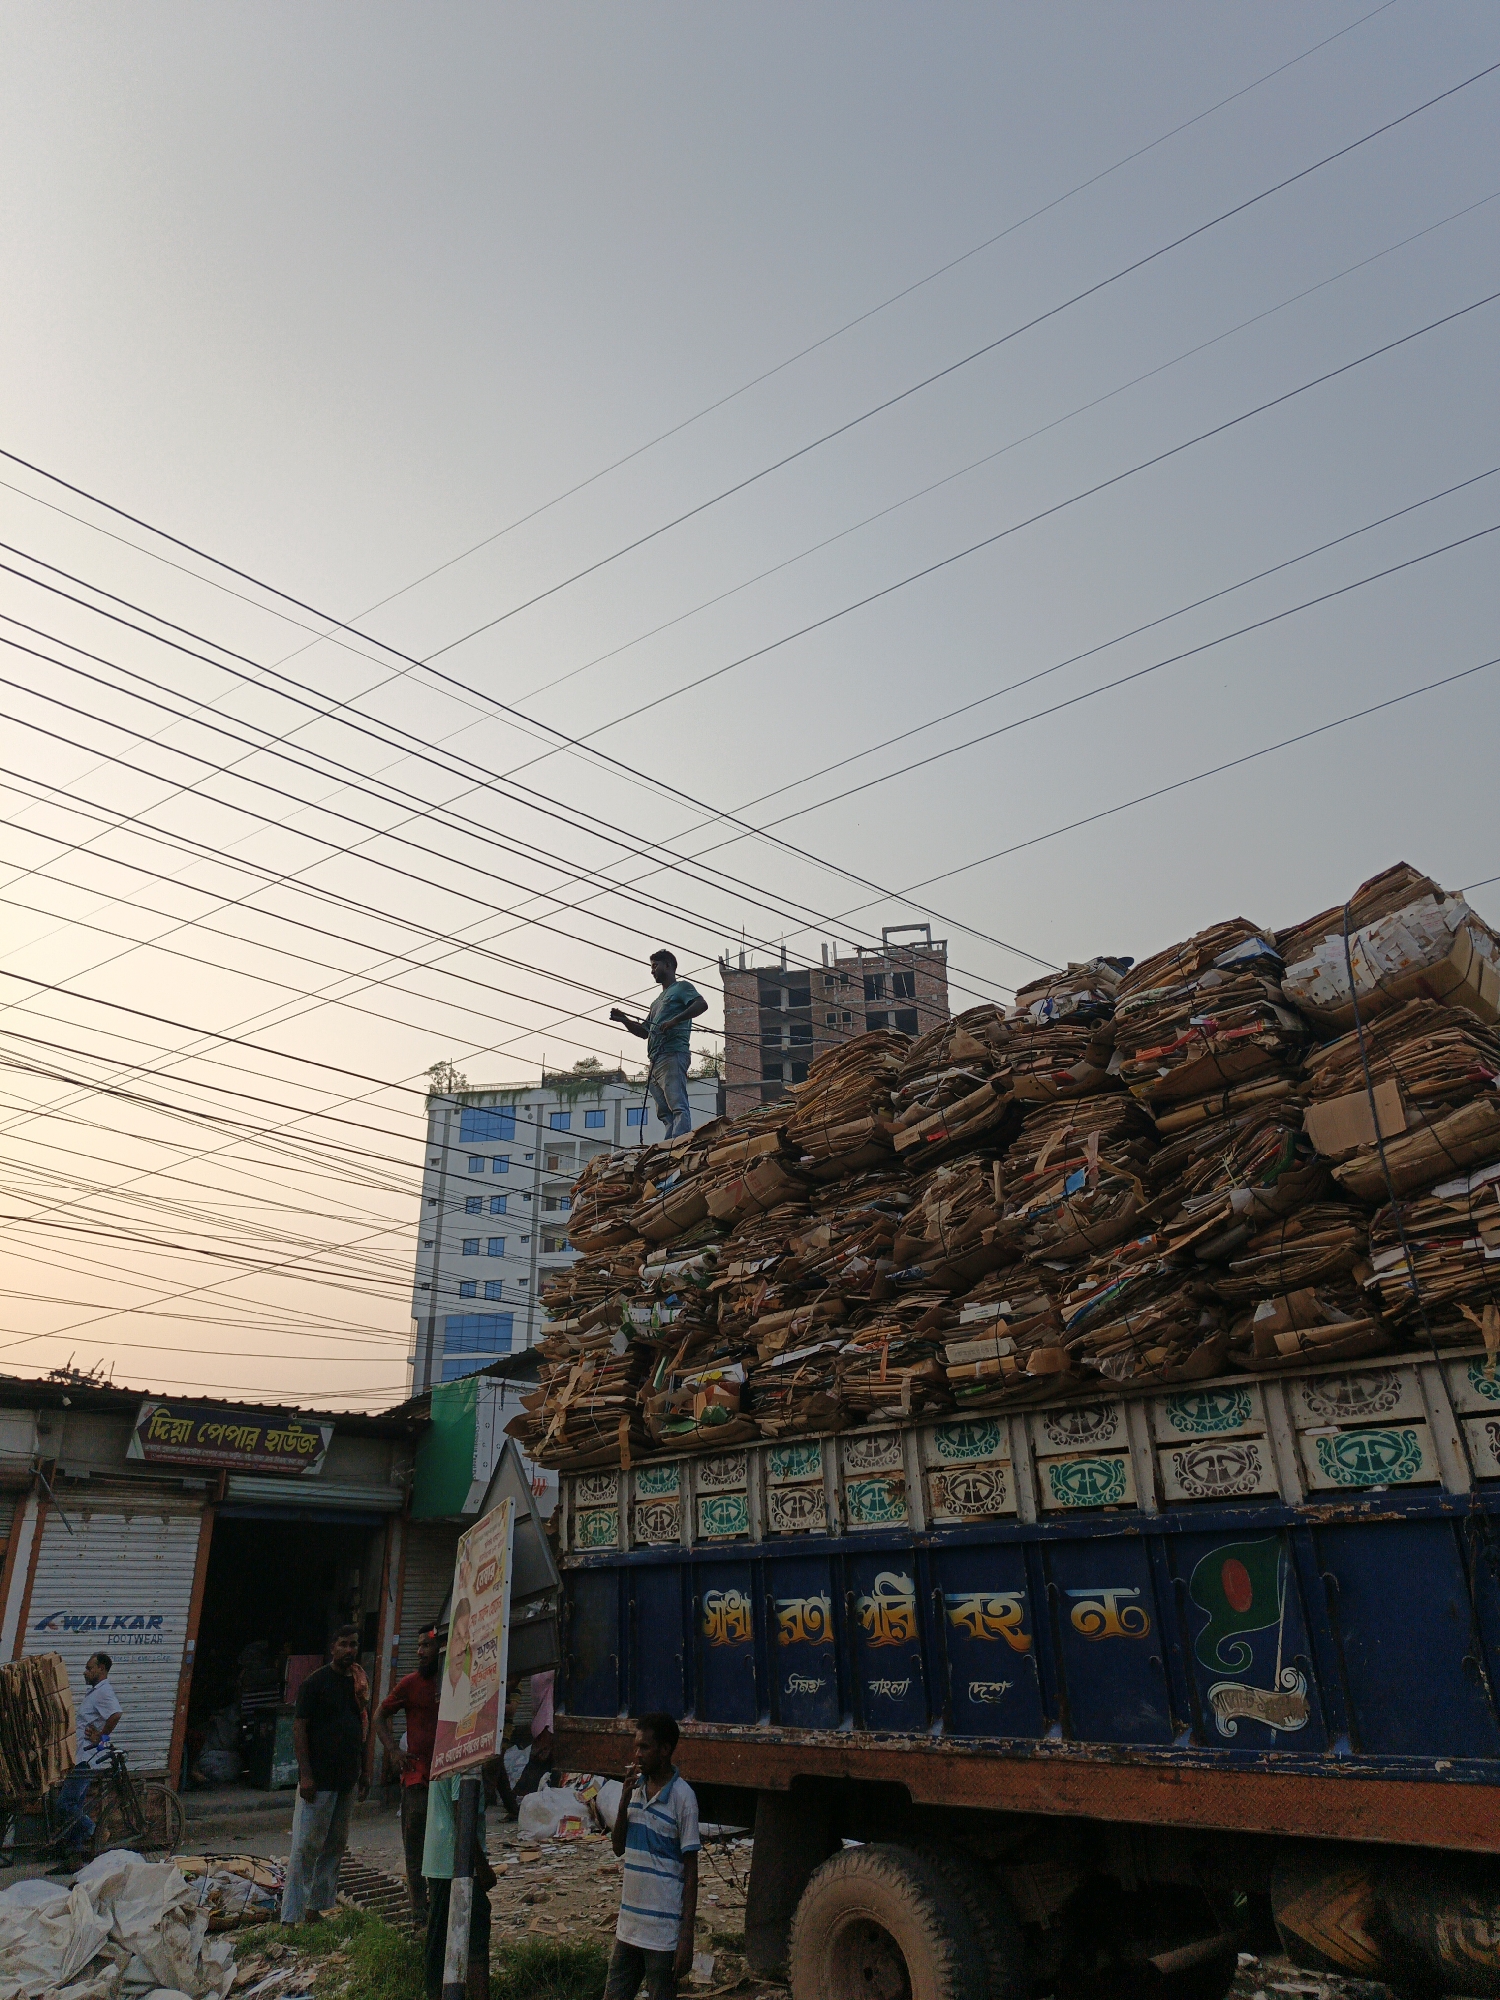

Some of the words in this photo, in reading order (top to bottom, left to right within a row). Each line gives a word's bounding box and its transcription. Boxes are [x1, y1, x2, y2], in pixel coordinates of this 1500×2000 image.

[147, 1408, 194, 1444] দিয়া
[197, 1423, 261, 1452] পেপার
[264, 1425, 319, 1454] হাউজ
[63, 1615, 163, 1631] WALKAR
[108, 1633, 163, 1645] FOOTWEAR
[868, 1678, 912, 1701] বাংলা
[968, 1680, 1014, 1704] দেশ
